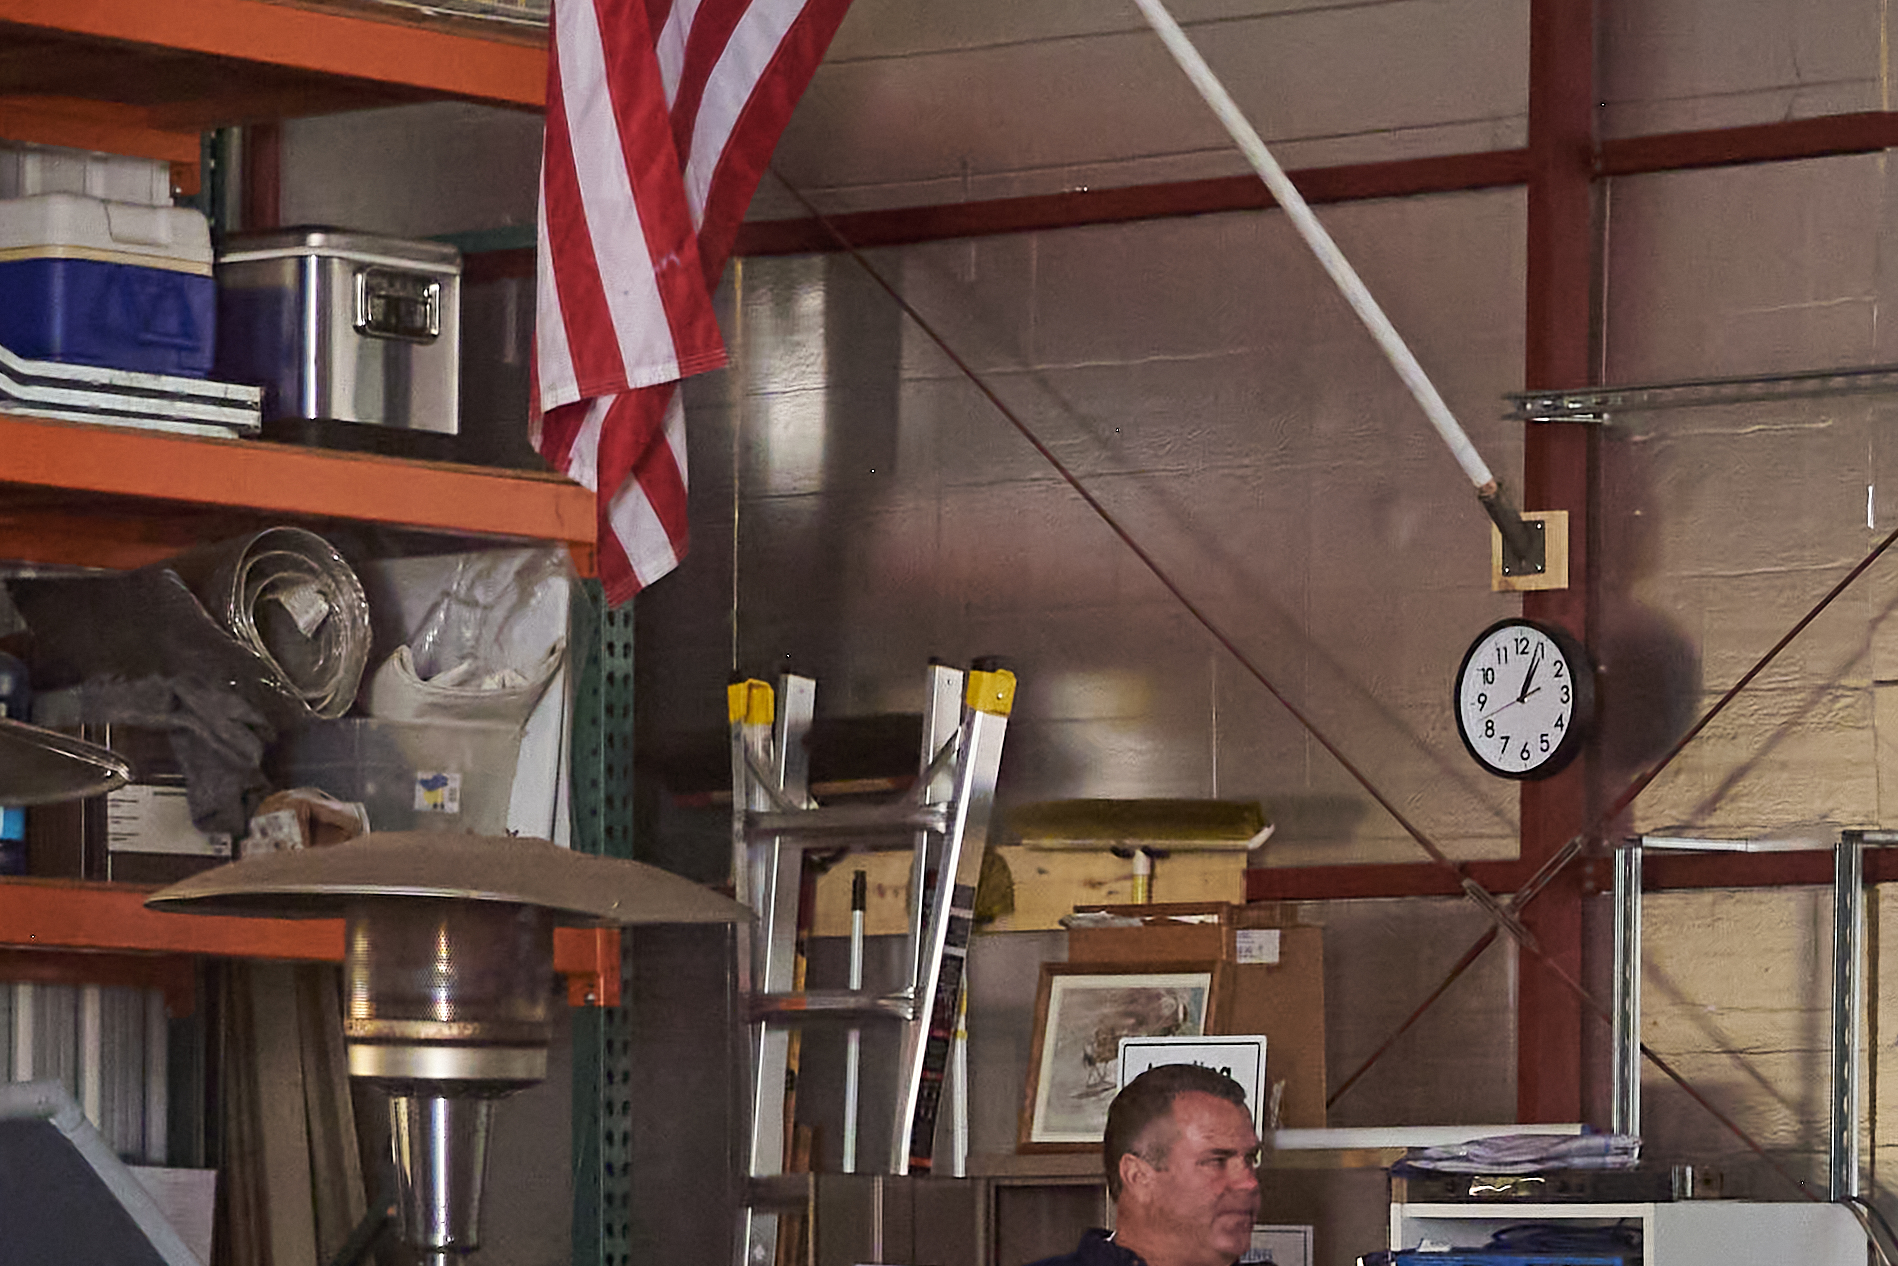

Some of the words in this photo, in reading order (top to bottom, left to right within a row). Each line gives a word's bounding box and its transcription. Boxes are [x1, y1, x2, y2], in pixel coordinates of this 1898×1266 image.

[1496, 646, 1508, 664] 11
[1514, 637, 1530, 655] 12
[1482, 667, 1495, 684] 10
[1553, 660, 1563, 678] 2
[1477, 692, 1487, 711] 9
[1560, 685, 1570, 704] 3
[1485, 719, 1494, 738] 8
[1554, 713, 1564, 731] 4
[1500, 735, 1510, 754] 7
[1520, 741, 1530, 760] 6
[1540, 733, 1550, 752] 5
